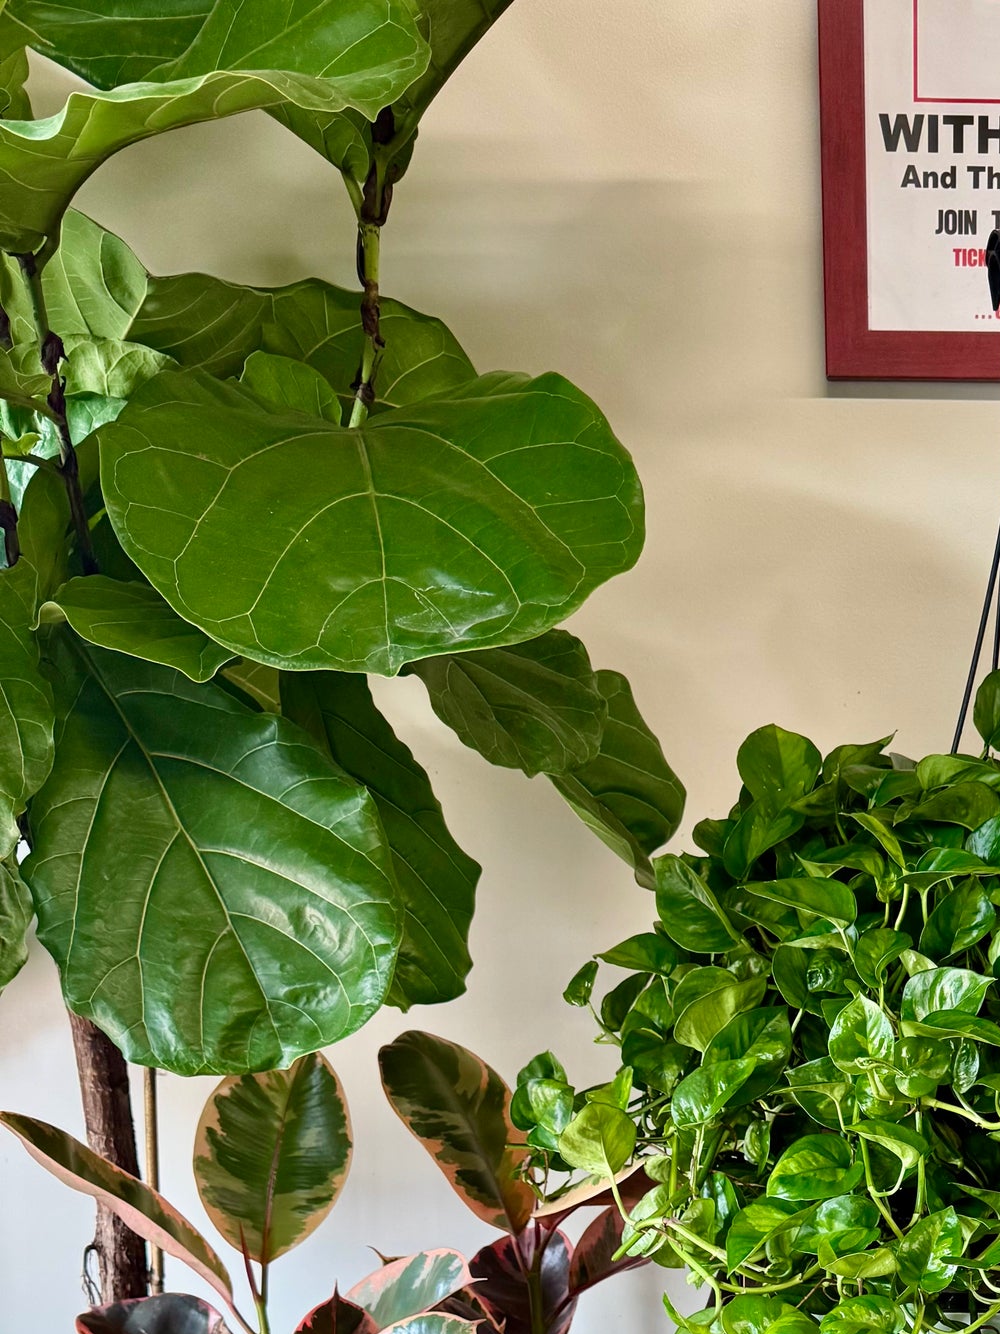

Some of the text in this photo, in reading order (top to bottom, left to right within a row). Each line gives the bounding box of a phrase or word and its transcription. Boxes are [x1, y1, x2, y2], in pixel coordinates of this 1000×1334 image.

[900, 164, 957, 189] And
[935, 209, 977, 236] JOIN
[953, 248, 987, 267] TICK
